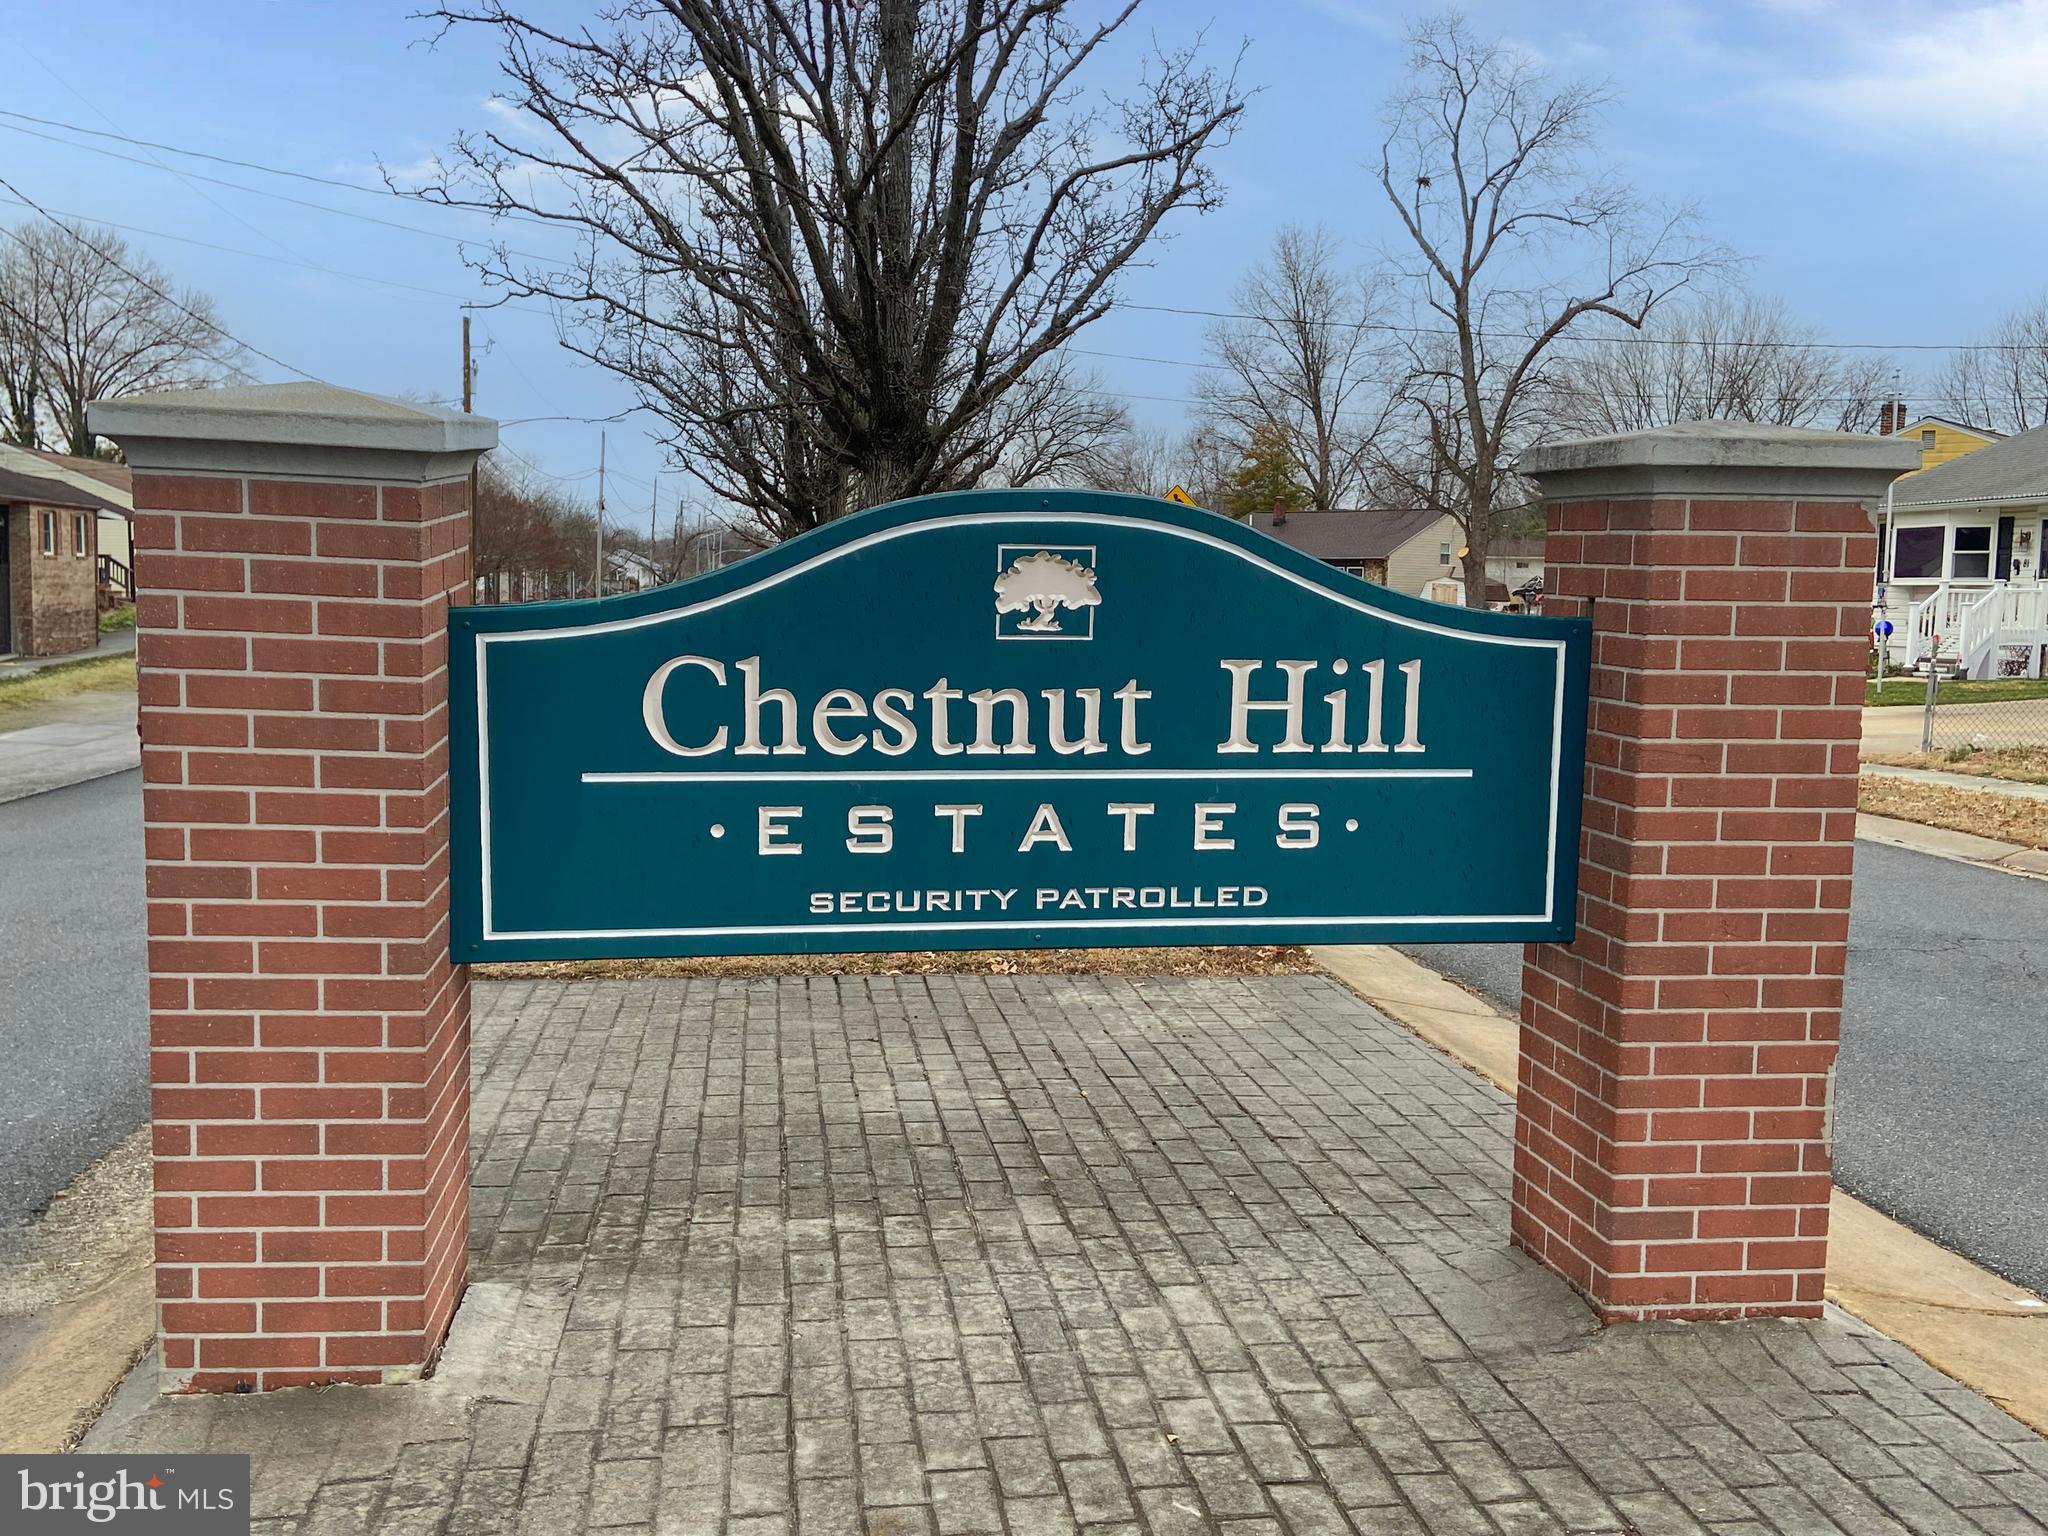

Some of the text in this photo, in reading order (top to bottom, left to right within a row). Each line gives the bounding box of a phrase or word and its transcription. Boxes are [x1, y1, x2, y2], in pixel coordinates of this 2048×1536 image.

[641, 654, 1427, 757] Chestnut Hill
[757, 802, 1321, 856] ESTATES
[808, 886, 1268, 914] SECURITY PATROLLED
